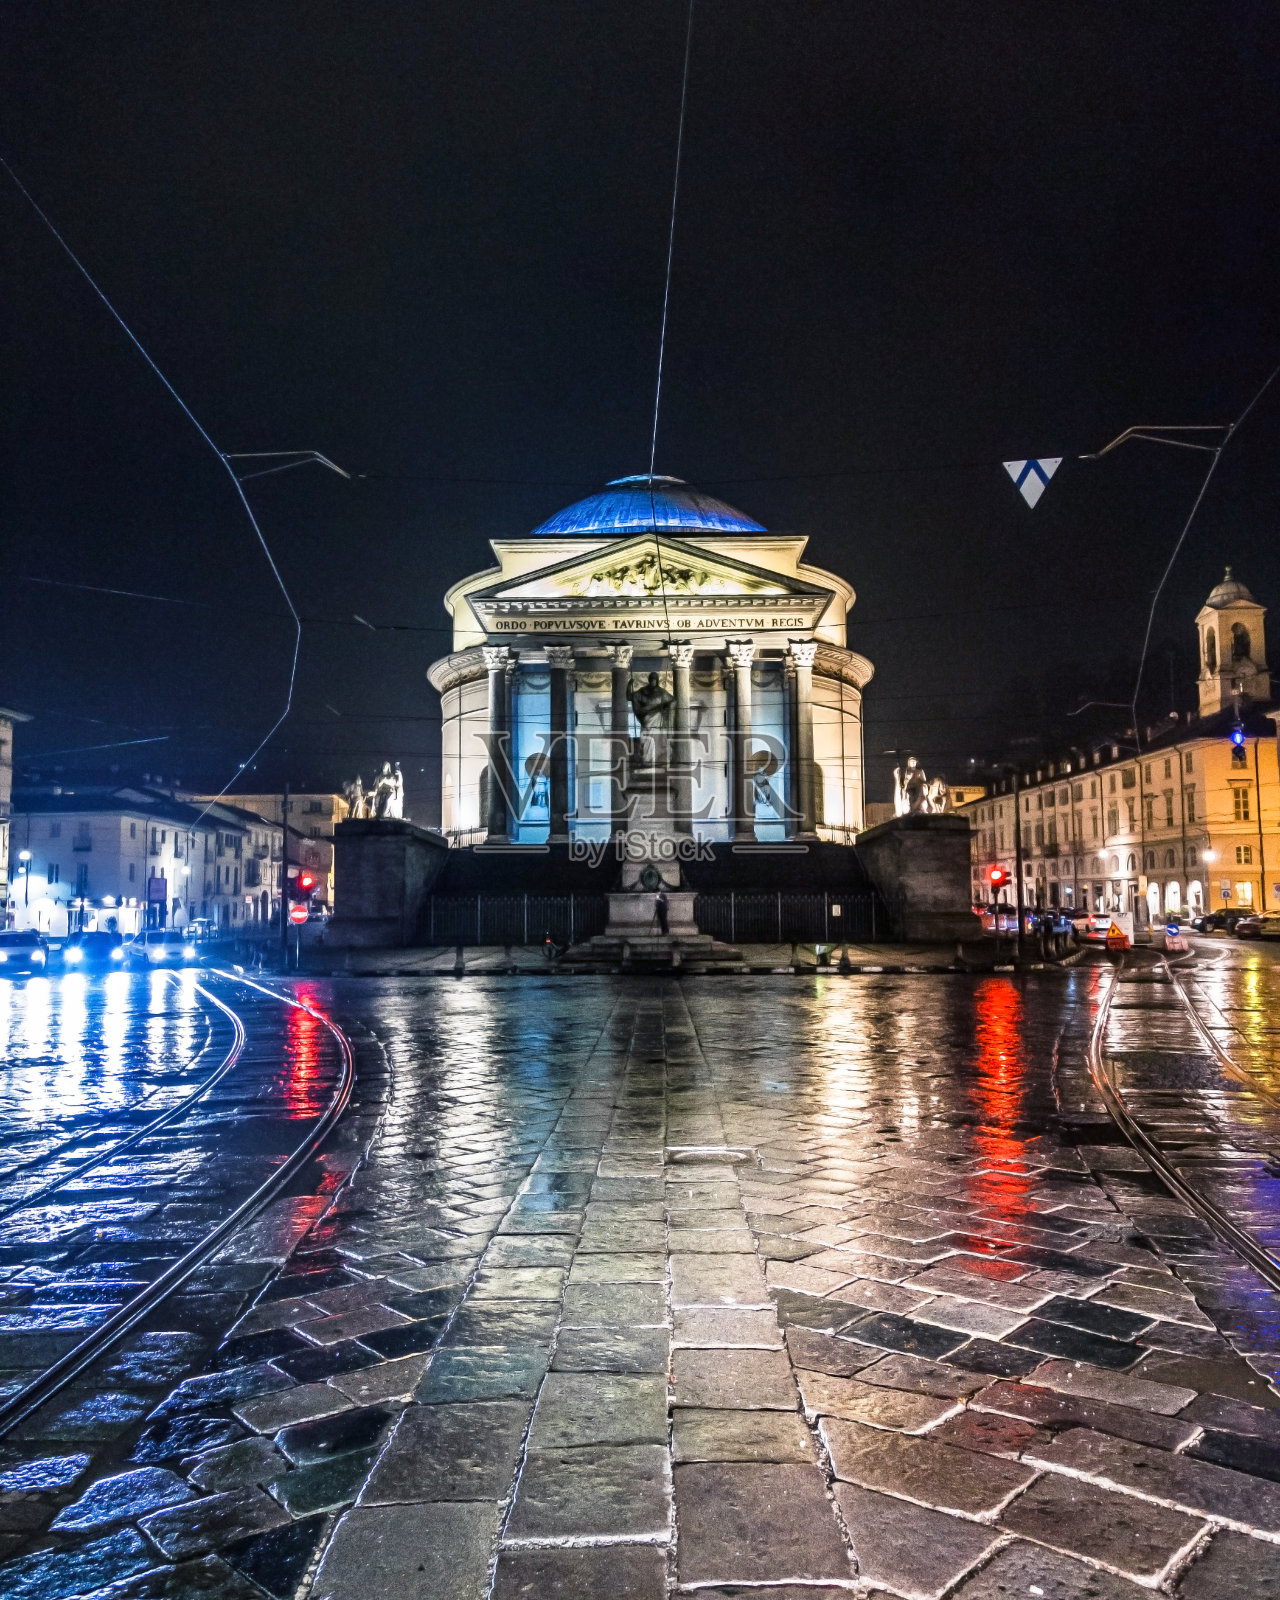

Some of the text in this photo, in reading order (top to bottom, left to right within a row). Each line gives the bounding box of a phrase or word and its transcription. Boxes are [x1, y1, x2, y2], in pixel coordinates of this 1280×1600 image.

[495, 618, 804, 631] ORDO POPVLVSQVE TAVRINVS OB ADVENTVM REGIS
